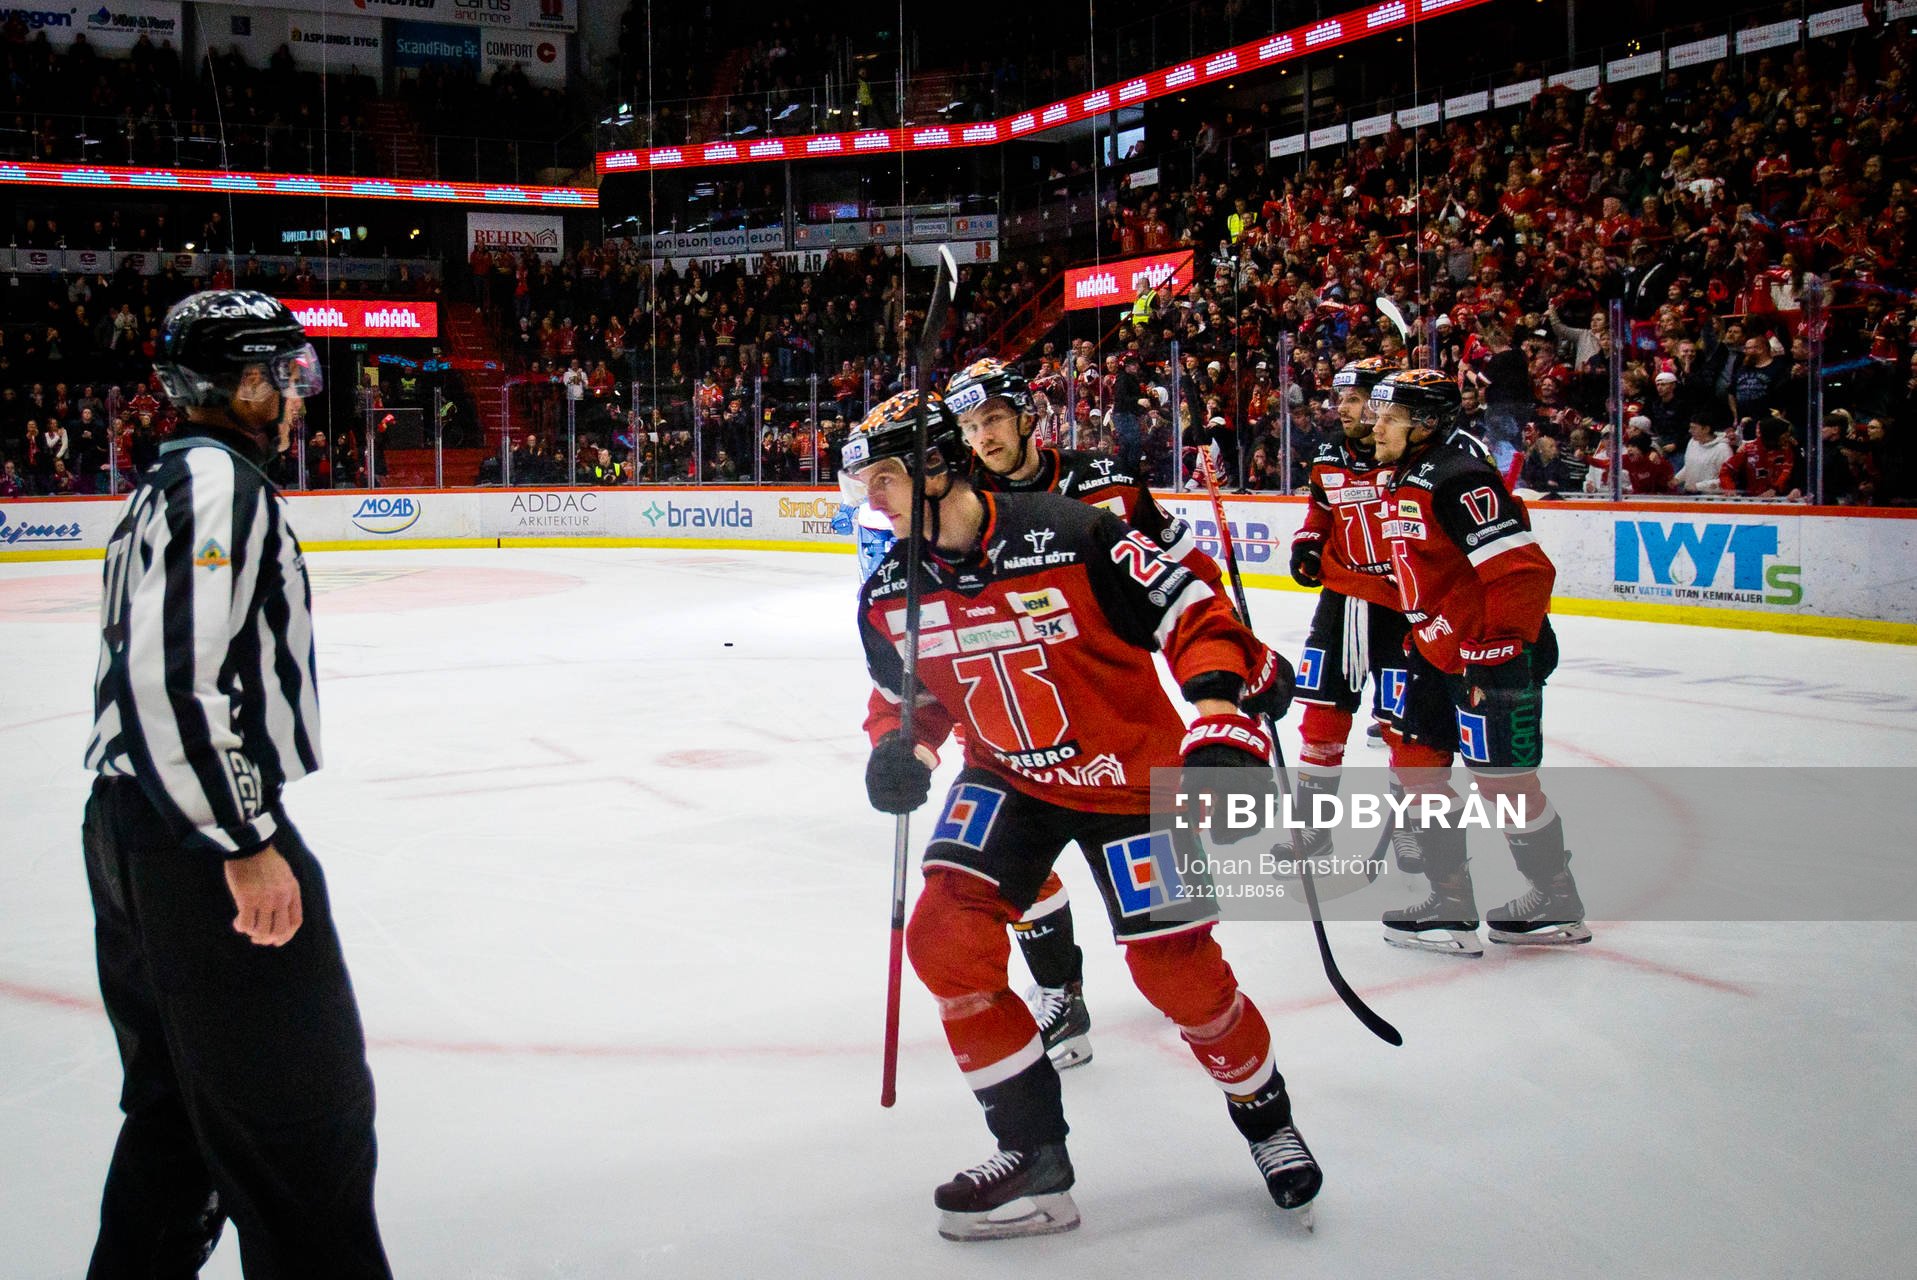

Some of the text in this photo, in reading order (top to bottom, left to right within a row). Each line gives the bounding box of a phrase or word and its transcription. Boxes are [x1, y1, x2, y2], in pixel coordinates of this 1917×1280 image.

[455, 9, 511, 24] and more
[354, 37, 379, 48] BYGG
[395, 37, 463, 58] ScandFibre
[486, 41, 533, 58] COMFORT
[474, 229, 536, 246] BEHRN
[804, 250, 822, 272] ÄR
[1076, 272, 1119, 298] MÅÅÅL
[365, 307, 420, 328] MÅÅÅL
[1078, 473, 1134, 492] NÄRKE KÖTT
[353, 498, 414, 518] MOAB
[511, 492, 598, 513] ADDAC
[1460, 486, 1499, 526] 17
[518, 516, 590, 527] ARKITEKTUR
[668, 500, 753, 528] bravida
[0, 510, 82, 544] ejmes
[1004, 551, 1076, 570] NÄRKE KÖTT
[1614, 584, 1763, 604] RENT VATTEN UTAN KEMIKALIER
